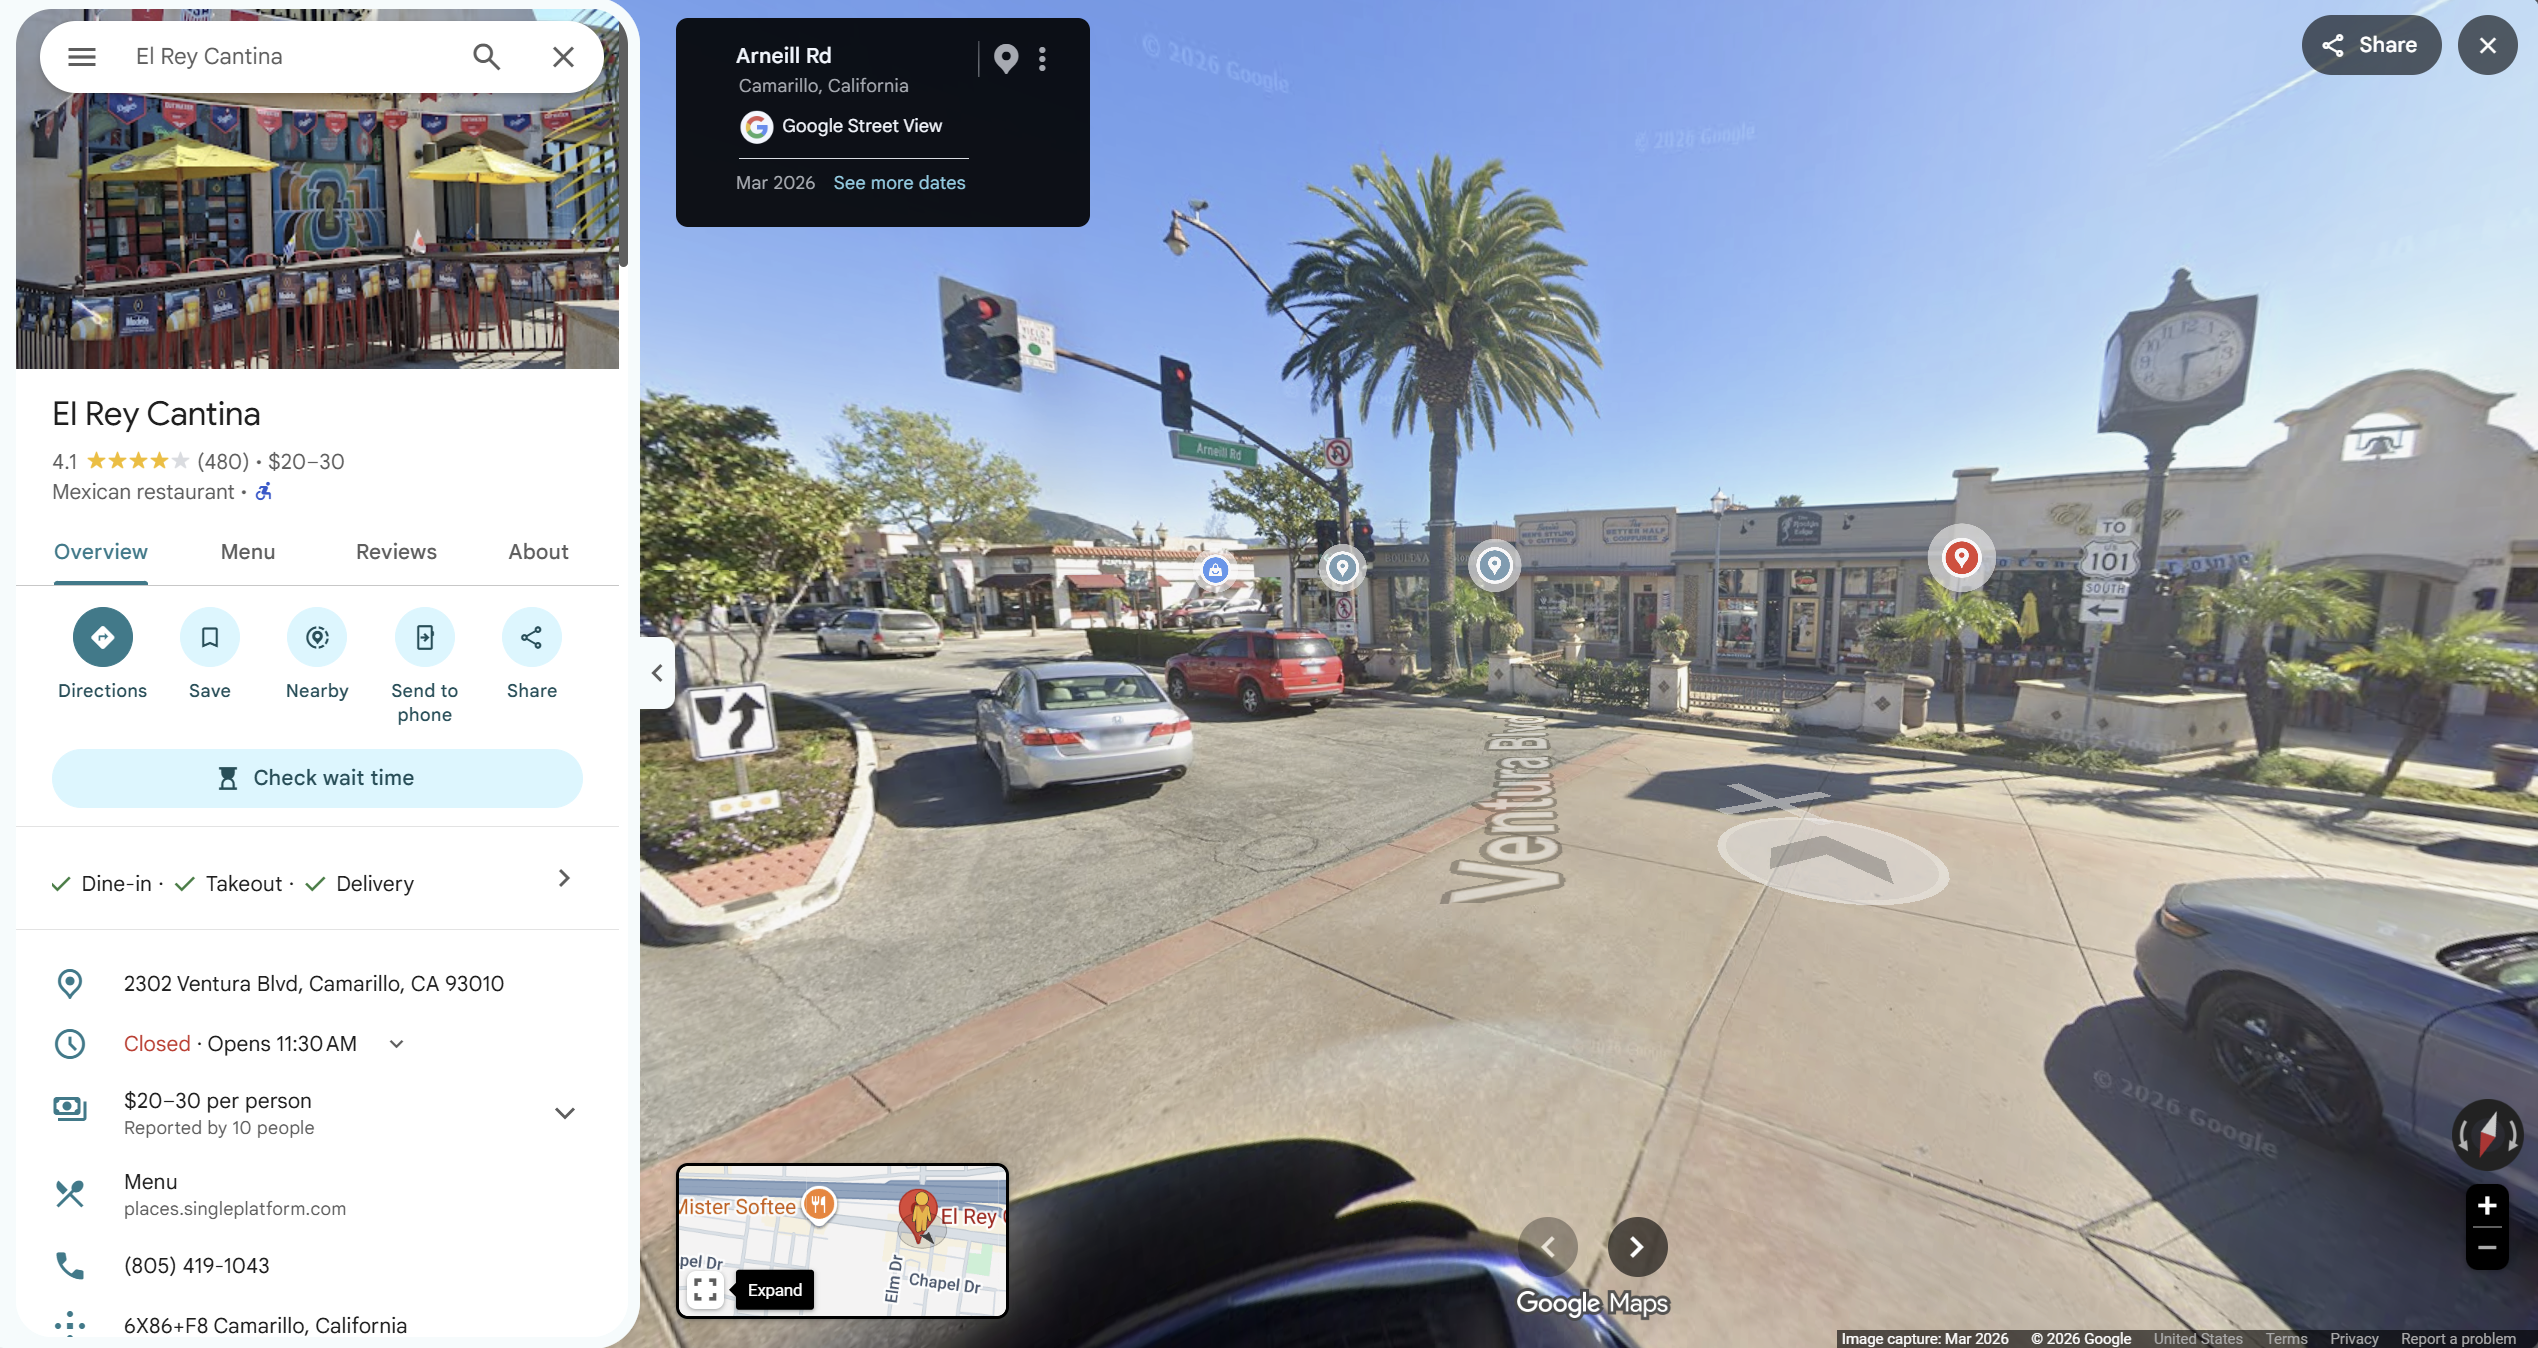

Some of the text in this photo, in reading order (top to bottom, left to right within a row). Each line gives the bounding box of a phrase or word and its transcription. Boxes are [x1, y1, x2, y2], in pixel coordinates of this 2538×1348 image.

[2181, 319, 2198, 332] 12
[2208, 322, 2214, 333] 1
[2162, 326, 2172, 338] 11
[2219, 330, 2231, 344] 2
[2221, 348, 2234, 359] 3
[2140, 357, 2150, 368] 9
[2144, 374, 2153, 382] 8
[1197, 442, 1242, 461] Arneill Rd
[2103, 521, 2126, 534] TO
[1613, 534, 1658, 542] COIFFURES
[1385, 554, 1430, 563] BOULEVA
[2092, 552, 2129, 571] 101
[2085, 583, 2126, 594] SOUTH
